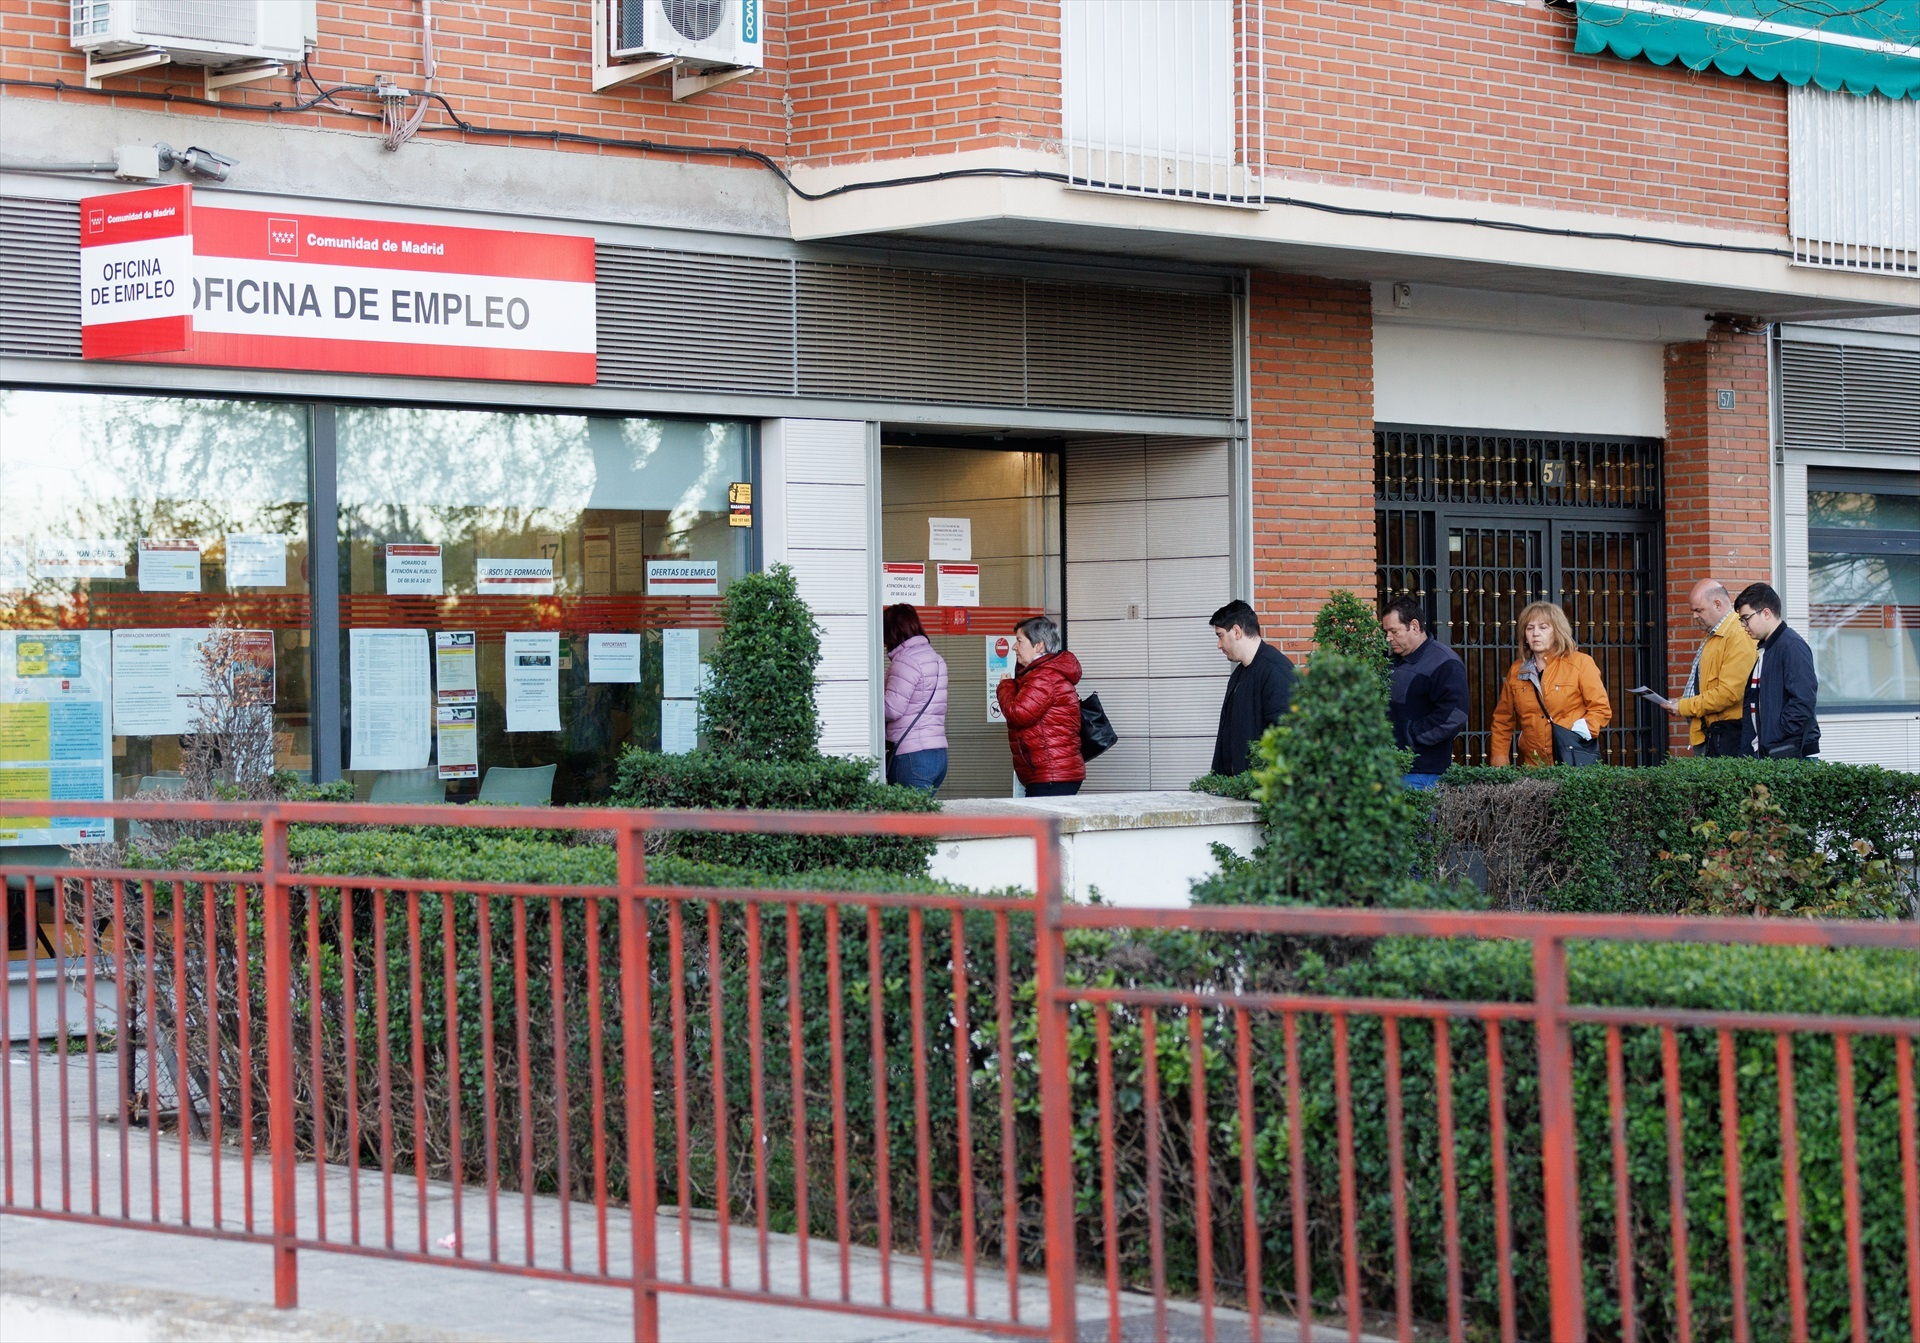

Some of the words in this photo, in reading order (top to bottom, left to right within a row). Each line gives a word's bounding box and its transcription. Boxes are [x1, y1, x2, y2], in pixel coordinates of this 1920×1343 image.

[107, 211, 142, 224] Comunidad
[143, 210, 153, 219] de
[153, 207, 175, 218] Madrid
[306, 233, 379, 251] Comunidad
[382, 239, 398, 252] de
[401, 240, 445, 255] Madrid
[103, 258, 162, 281] OFICINA
[91, 287, 110, 305] DE
[115, 279, 175, 303] EMPLEO
[334, 285, 380, 321] DE
[392, 289, 530, 330] EMPLEO
[1721, 392, 1731, 406] 57
[1543, 463, 1565, 483] 57
[480, 568, 504, 576] CURSOS
[504, 568, 513, 576] DE
[513, 567, 552, 576] FORMACIÓN
[651, 568, 679, 576] OFERTAS
[680, 568, 690, 576] DE
[690, 568, 716, 576] EMPLEO
